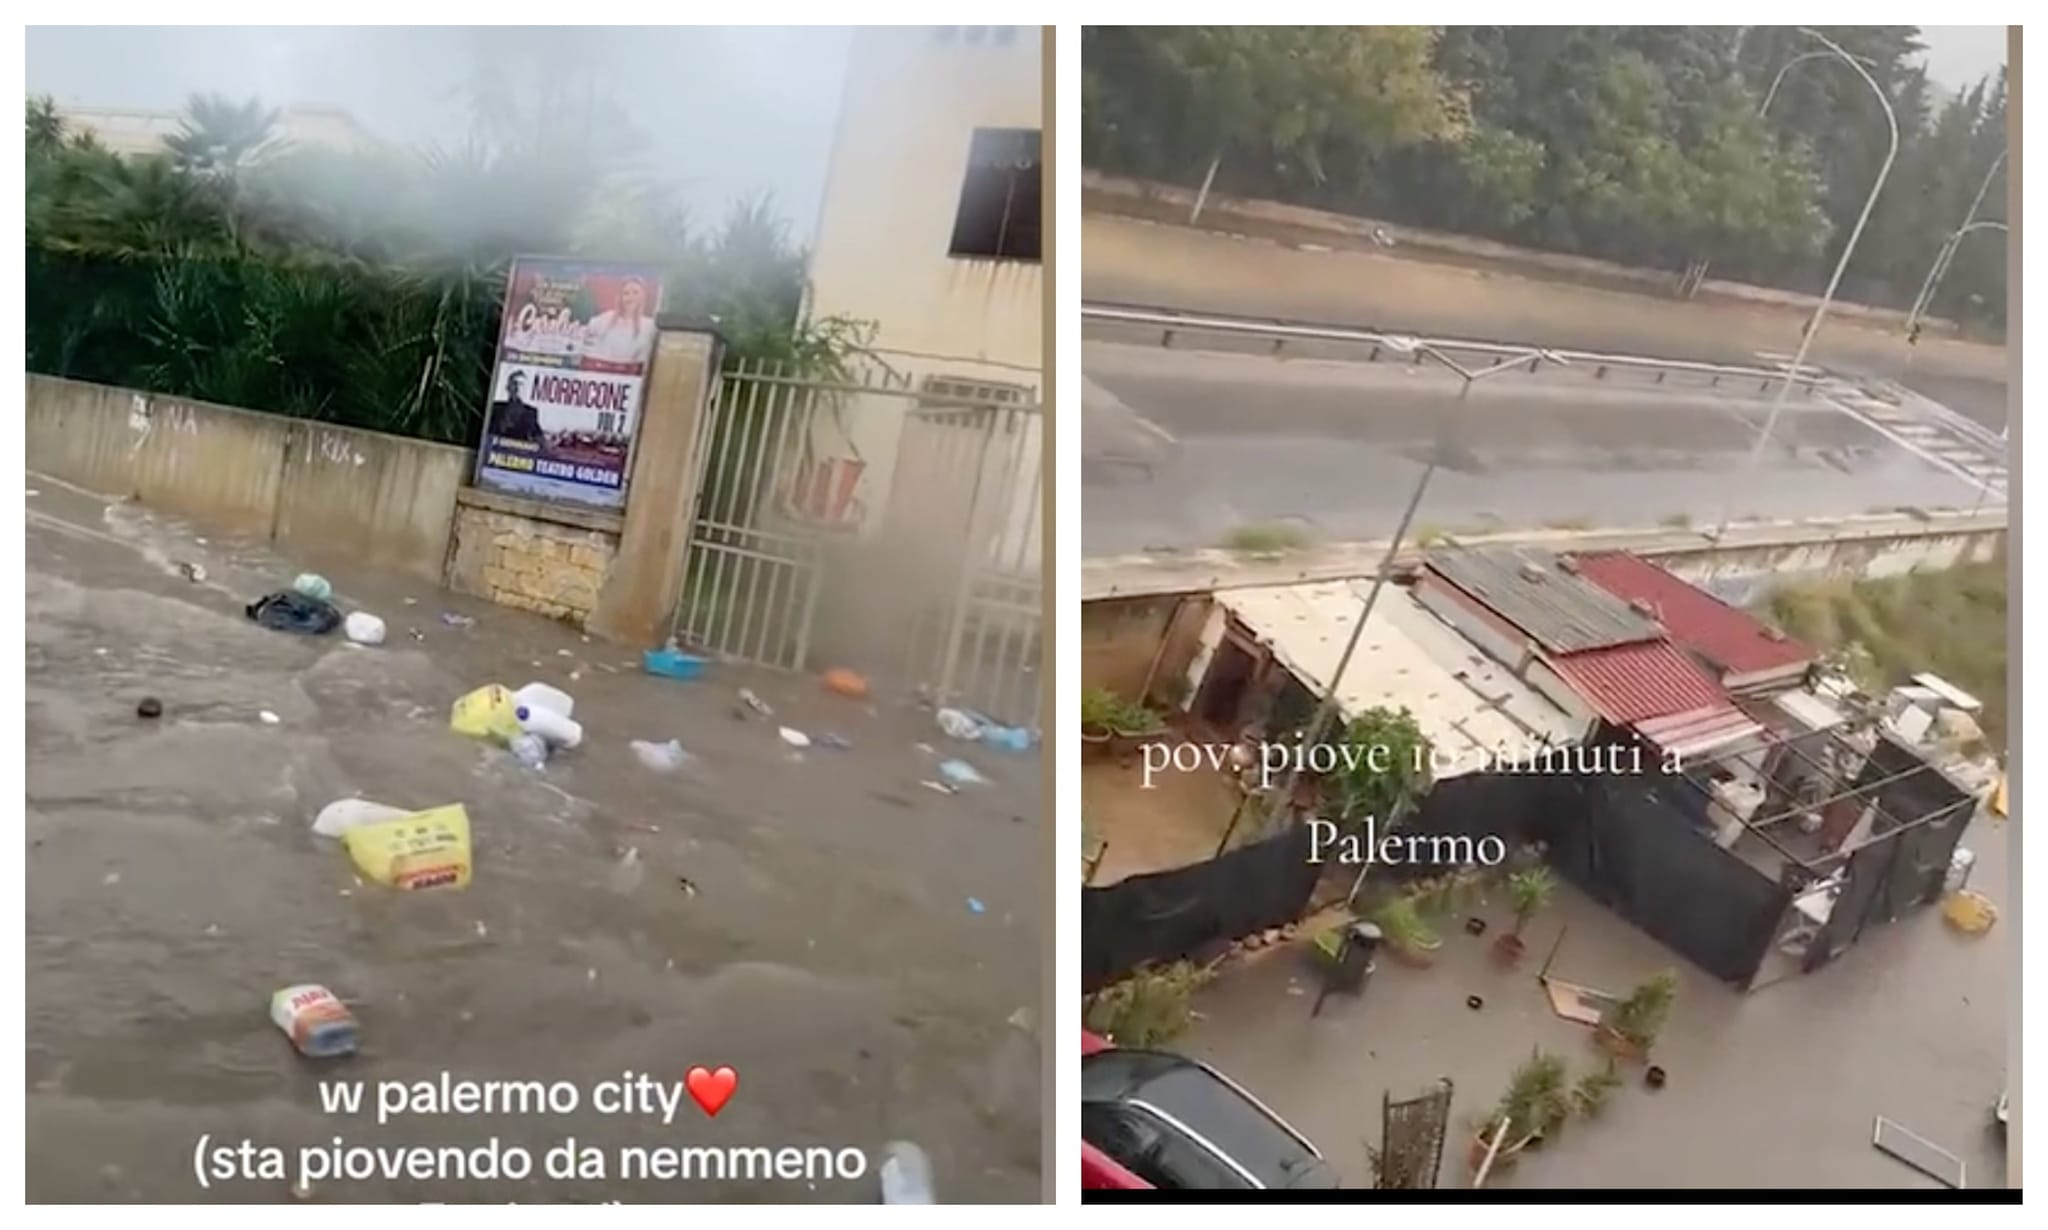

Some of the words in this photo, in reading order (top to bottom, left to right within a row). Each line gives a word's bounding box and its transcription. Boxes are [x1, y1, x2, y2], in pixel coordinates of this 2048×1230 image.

[531, 375, 631, 412] MORRICONE
[488, 453, 534, 471] PALERMO
[536, 459, 575, 478] TEATRO
[576, 466, 619, 486] GOLDEN
